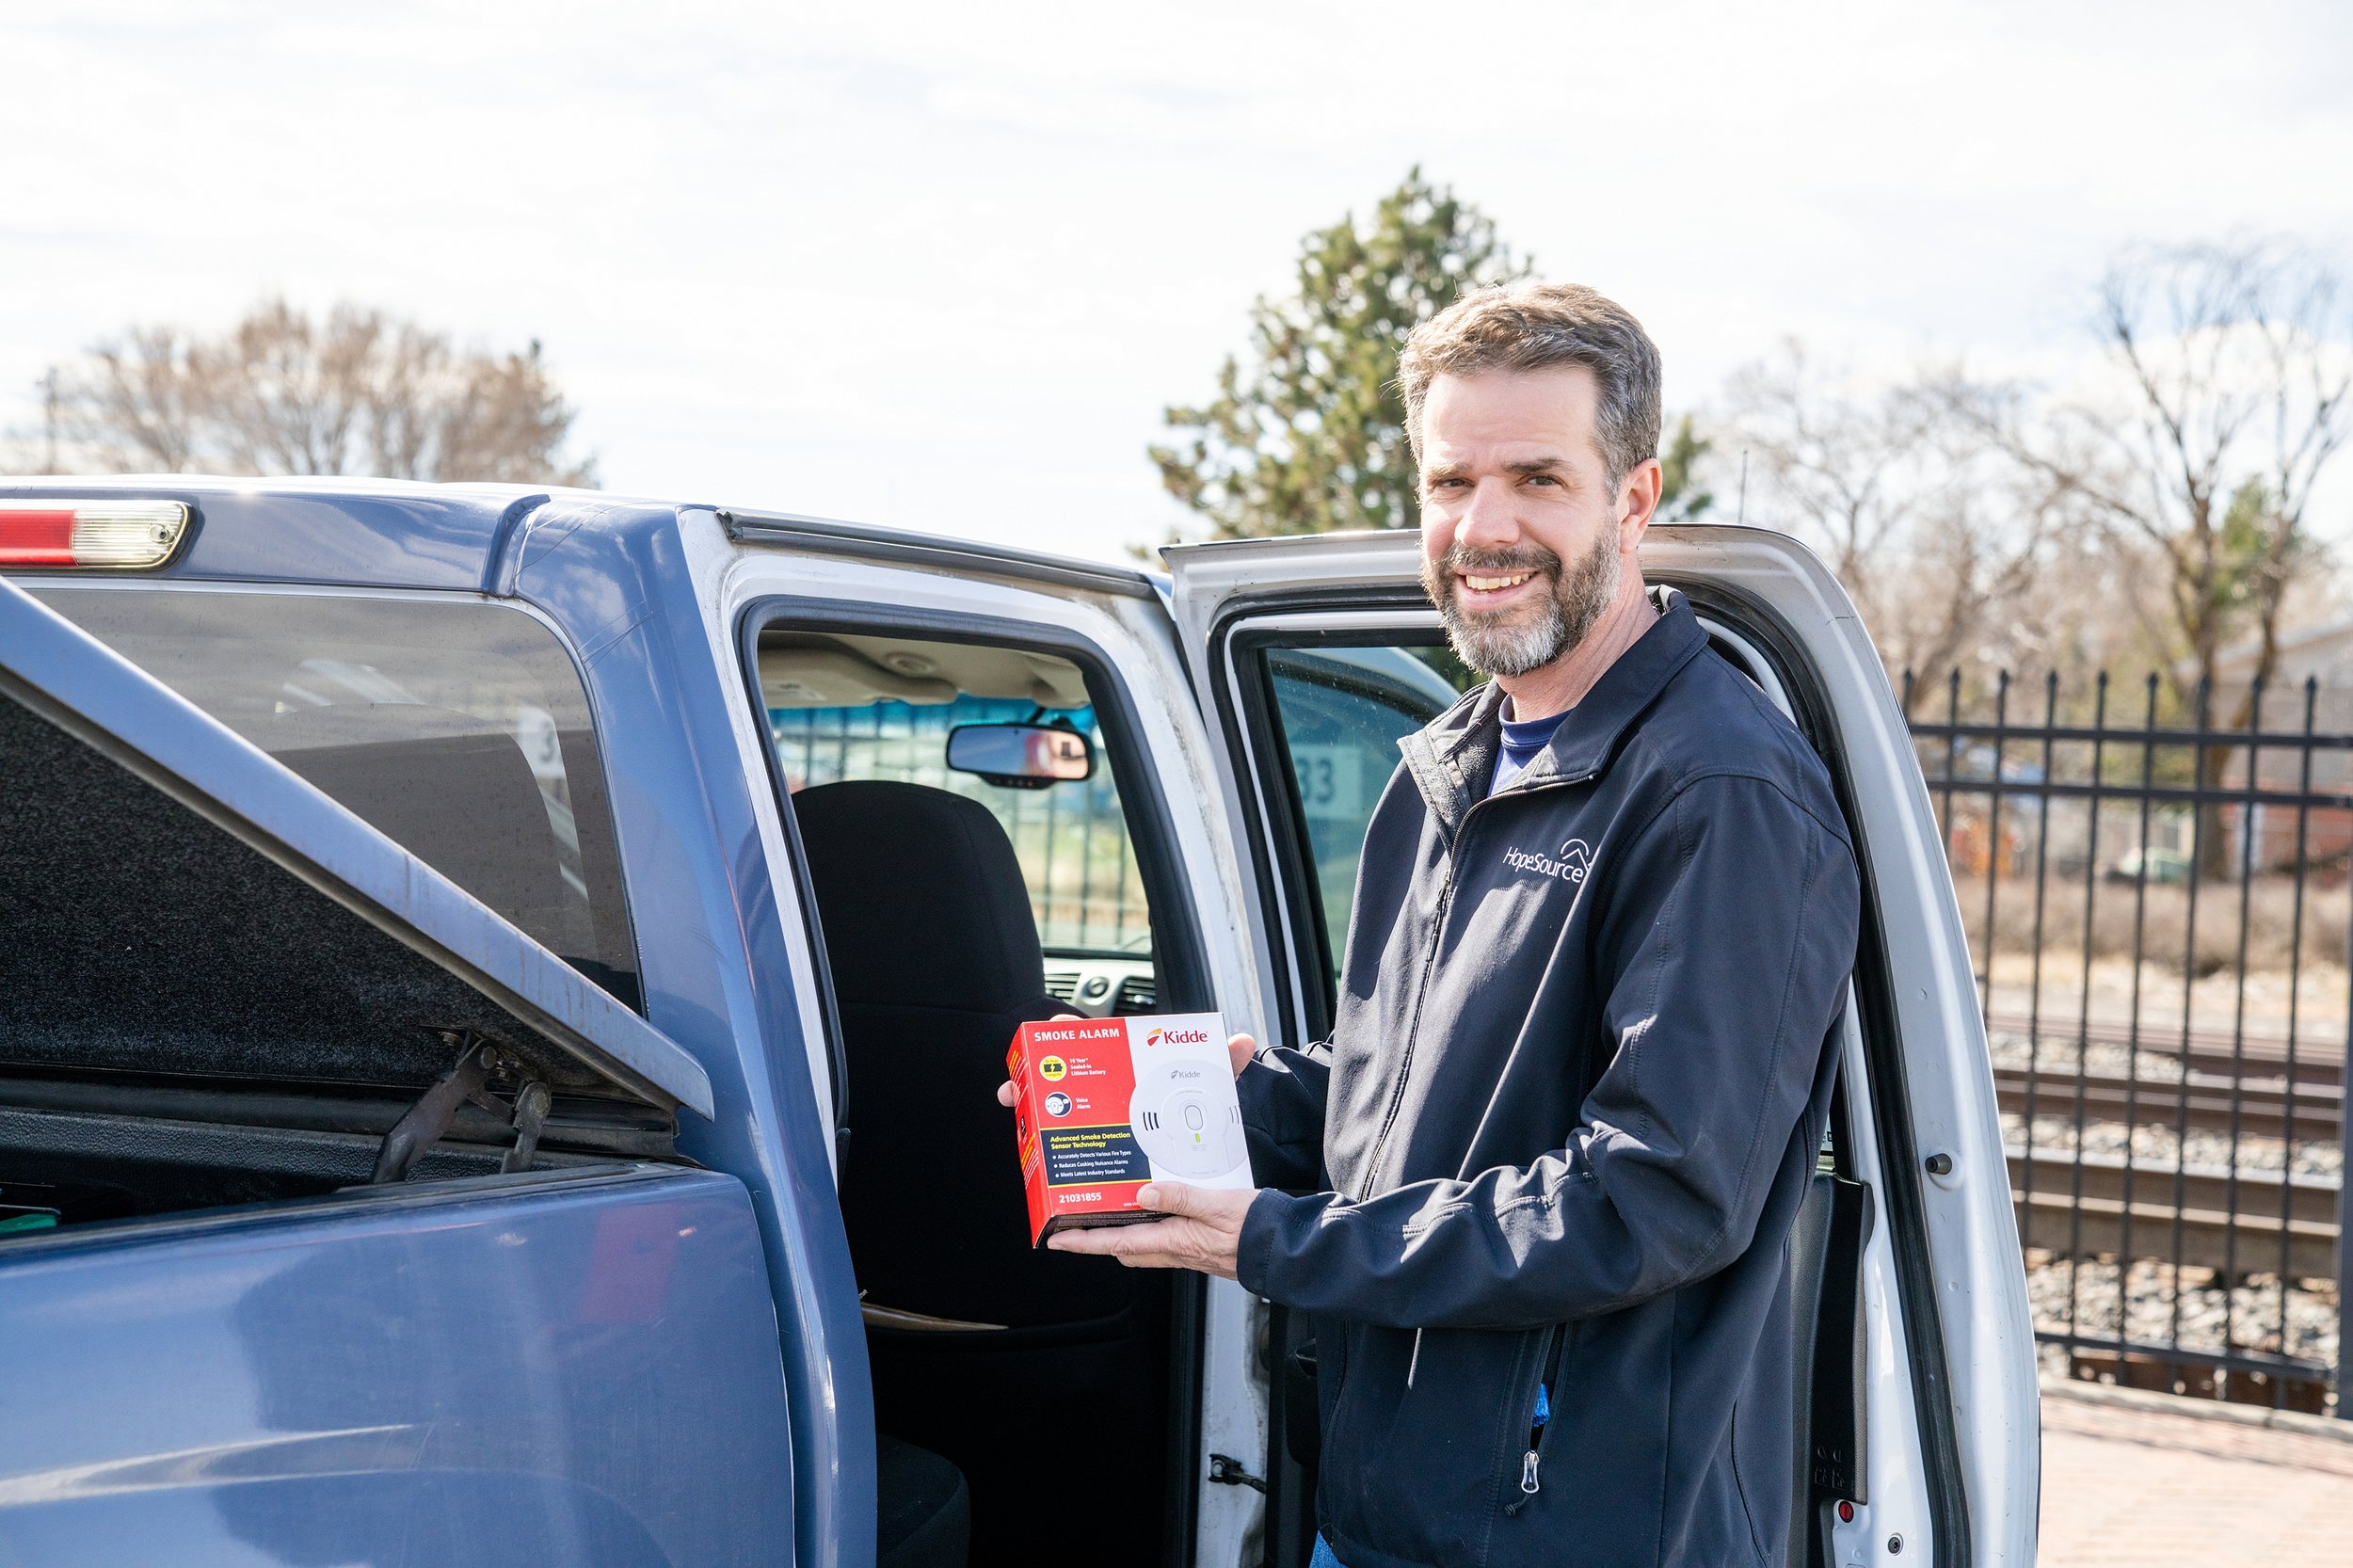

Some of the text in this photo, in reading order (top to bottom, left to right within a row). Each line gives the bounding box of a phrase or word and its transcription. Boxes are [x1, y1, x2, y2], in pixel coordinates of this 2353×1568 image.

[1502, 845, 1584, 884] HopeSource
[1034, 1028, 1119, 1041] SMOKE ALARM
[1163, 1030, 1208, 1045] Kidde
[1178, 1070, 1201, 1079] Kidde
[1050, 1134, 1080, 1143] Advanced
[1059, 1192, 1102, 1204] 21031855
